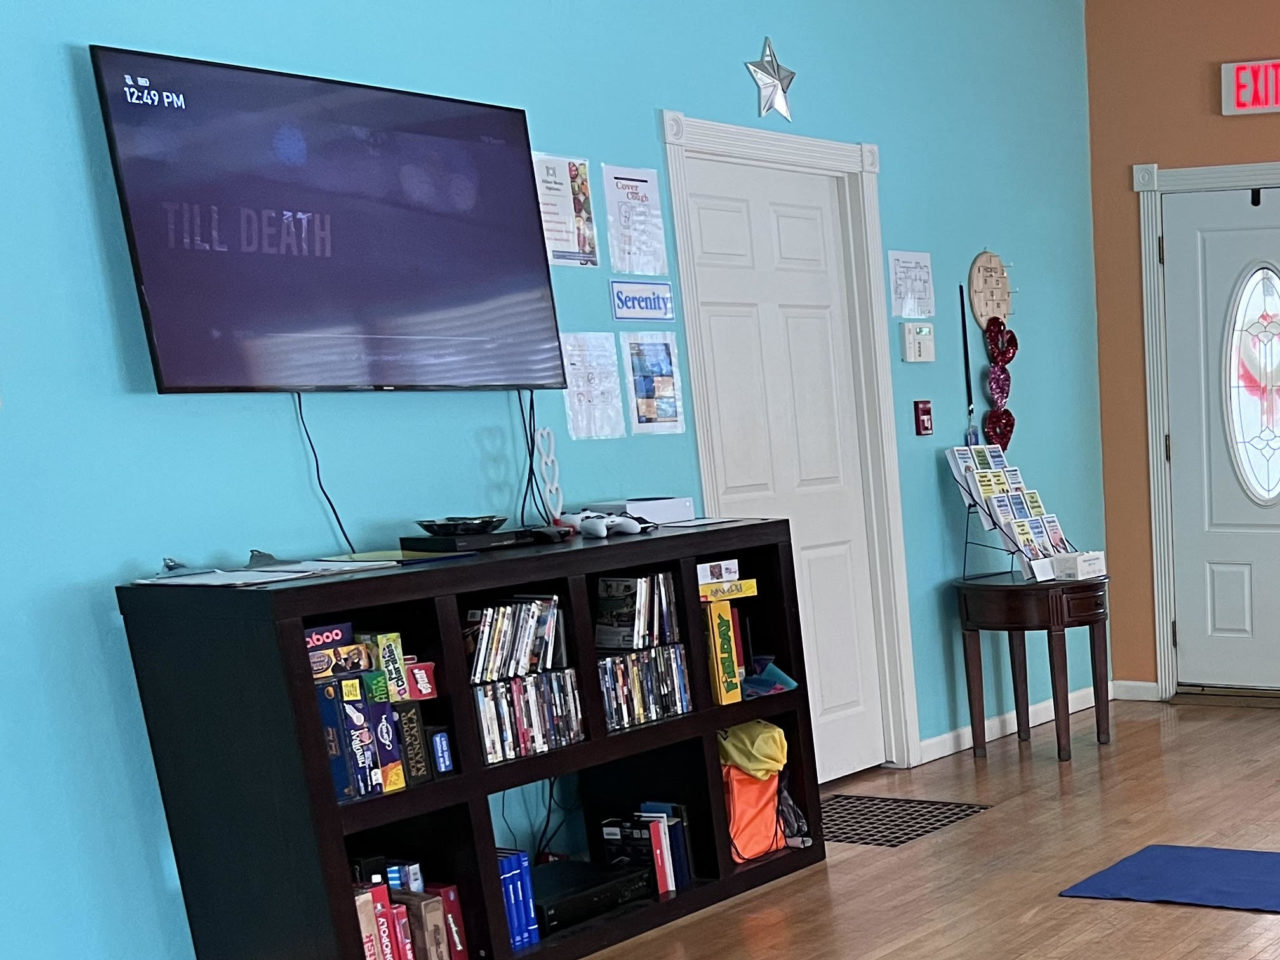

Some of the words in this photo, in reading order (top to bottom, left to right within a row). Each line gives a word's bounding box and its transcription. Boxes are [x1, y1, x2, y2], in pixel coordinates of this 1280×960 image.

[124, 87, 159, 105] 12:49
[163, 91, 186, 109] PM
[616, 181, 639, 191] Cover
[626, 191, 649, 203] Cough
[162, 202, 228, 251] TILL
[240, 207, 332, 257] DEATH
[616, 291, 669, 315] Serenity
[383, 659, 396, 682] Party
[386, 643, 405, 688] Charades
[401, 712, 411, 746] WOOD
[407, 708, 427, 776] MANCALA
[408, 747, 418, 776] SOLID
